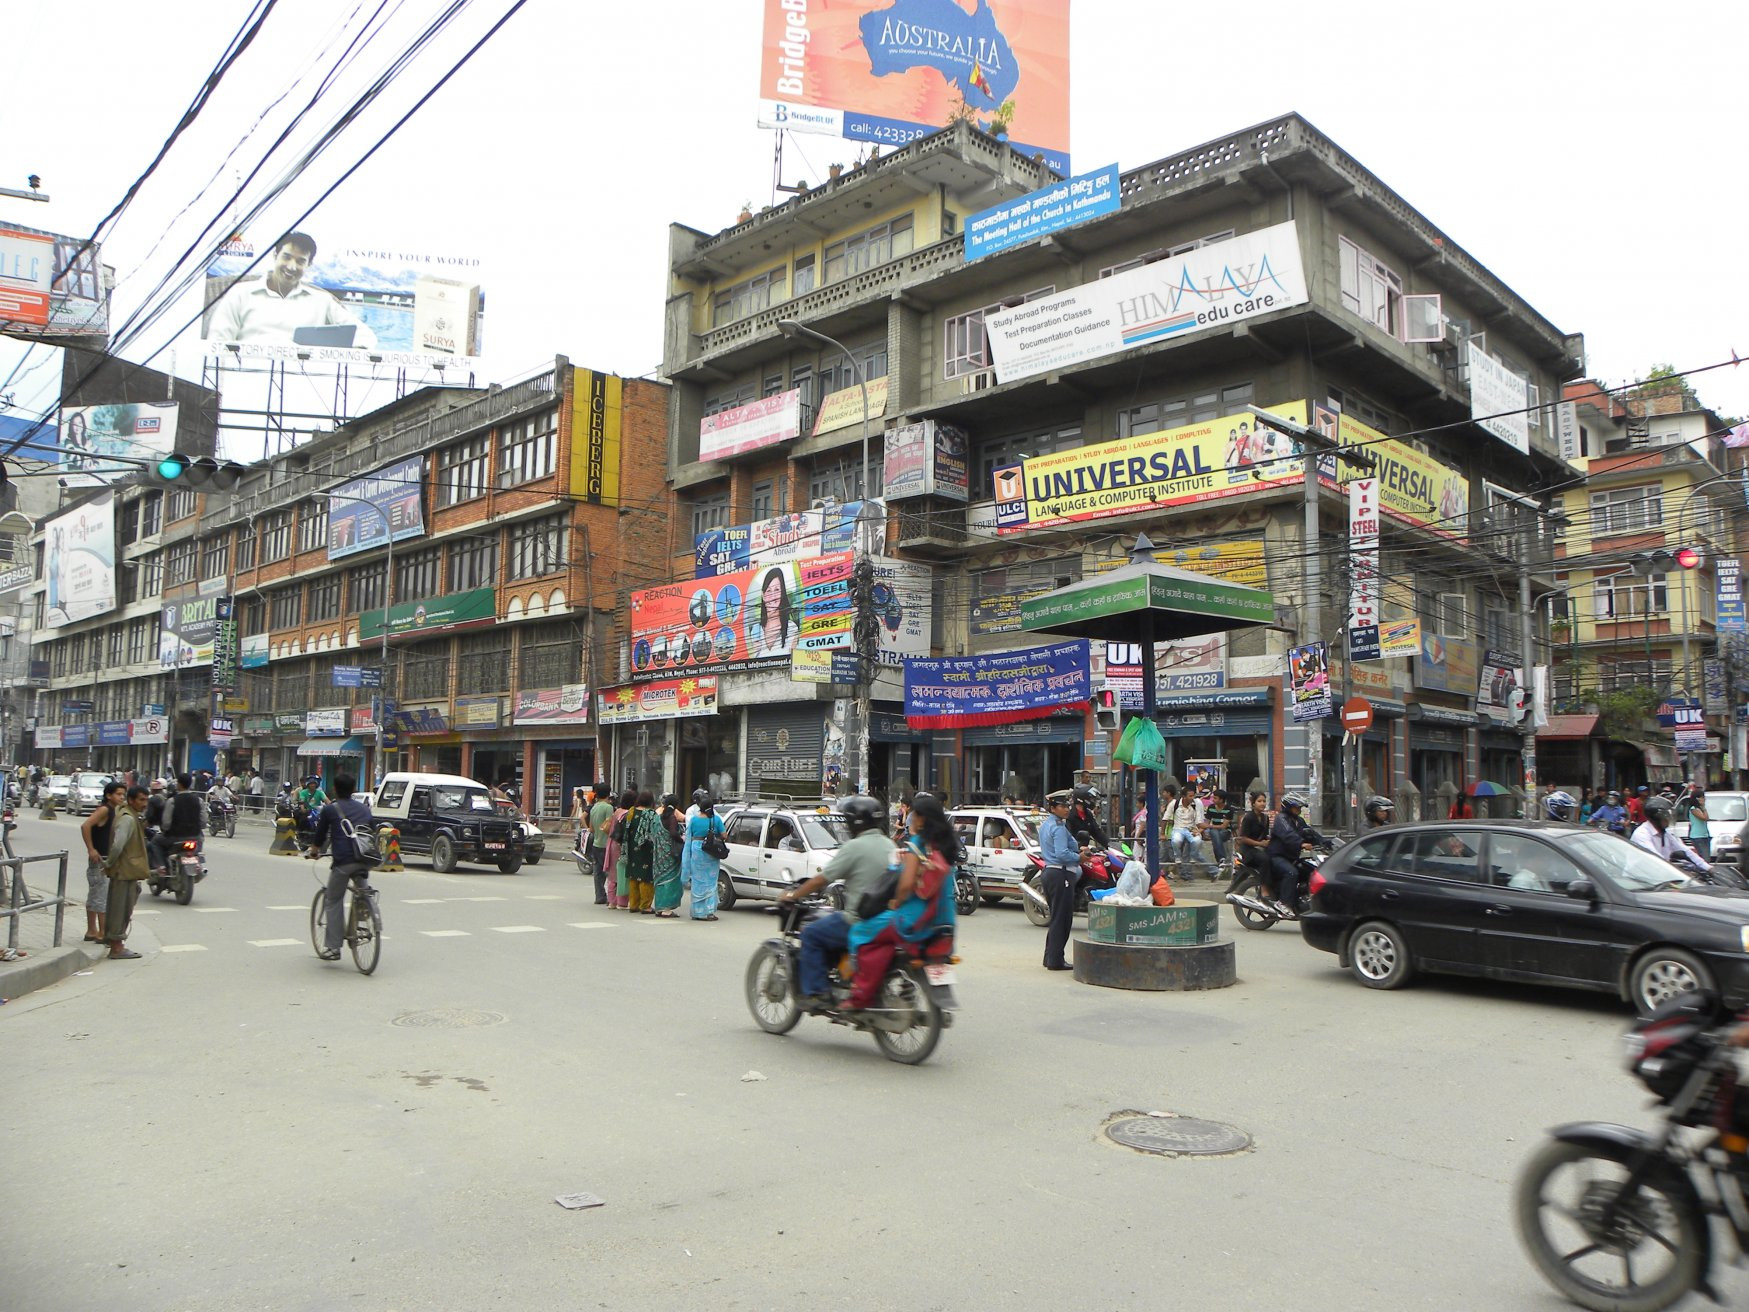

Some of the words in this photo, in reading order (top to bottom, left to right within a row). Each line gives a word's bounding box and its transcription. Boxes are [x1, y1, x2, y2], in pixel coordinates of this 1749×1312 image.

[879, 16, 1002, 70] AUSTRALIA
[850, 122, 872, 135] call:
[971, 234, 982, 247] The
[983, 226, 1008, 243] Meeting
[1009, 219, 1022, 232] Hall
[1022, 217, 1030, 227] of
[1030, 213, 1041, 225] the
[1041, 206, 1064, 221] Church
[1064, 202, 1072, 212] in
[1072, 189, 1111, 210] Kathmandu
[346, 249, 392, 260] INSPIRE
[399, 254, 431, 263] YOUR
[437, 257, 480, 267] WORLD
[1117, 253, 1288, 326] HIMALAYA
[993, 314, 1013, 329] Study
[1014, 307, 1039, 323] Abroad
[1040, 297, 1076, 317] Programs
[1197, 305, 1229, 325] edu
[1233, 292, 1274, 316] care
[1004, 328, 1019, 339] Test
[1020, 315, 1061, 336] Preparation
[1062, 307, 1092, 324] Classes
[423, 333, 456, 348] SURYA
[1020, 328, 1073, 351] Documentation
[1074, 317, 1111, 336] Guidance
[319, 350, 360, 361] SMOKING
[363, 352, 371, 361] IS
[424, 355, 434, 365] TO
[437, 356, 471, 368] HEALTH
[1471, 348, 1494, 376] STUDY
[1495, 365, 1504, 381] IN
[722, 409, 748, 422] ALTA
[760, 394, 791, 410] VISTA
[822, 410, 848, 425] SPANISH
[589, 380, 603, 494] ICEBERG
[1027, 462, 1040, 471] TEST
[1040, 454, 1078, 469] PREPARATION
[1083, 449, 1102, 459] STUDY
[1103, 444, 1128, 456] ABROAD
[1133, 436, 1169, 450] LANGUAGES
[1175, 427, 1212, 441] COMPUTING
[1032, 444, 1212, 503] UNIVERSAL
[1342, 437, 1436, 507] UNIVERSAL
[891, 481, 920, 492] UNIVERSAL
[1089, 495, 1097, 507] &
[1098, 486, 1155, 506] COMPUTER
[1158, 475, 1214, 497] INSTITUTE
[1380, 488, 1410, 510] COMPUTER
[998, 501, 1025, 516] ULCI
[1092, 510, 1112, 518] Email:
[1351, 519, 1378, 536] STEEL
[723, 530, 748, 541] TOEFL
[767, 524, 801, 549] Study
[716, 540, 742, 553] IELTS
[772, 543, 796, 557] Abroad
[709, 551, 732, 566] SAT
[799, 560, 812, 569] Test
[812, 554, 846, 568] Preparation
[1716, 560, 1740, 568] TOEFL
[716, 560, 736, 576] GRE
[807, 565, 845, 579] IELTS
[1717, 568, 1739, 576] IELTS
[1720, 576, 1737, 585] SAT
[644, 586, 682, 602] REACTION
[804, 583, 846, 597] TOEFL
[906, 592, 922, 601] IELTS
[1720, 585, 1737, 593] GRE
[1717, 593, 1741, 602] GMAT
[644, 604, 663, 616] Nepal
[812, 601, 838, 613] SAT
[905, 601, 923, 610] TOEFL
[811, 618, 838, 630] GRE
[907, 619, 920, 628] GRE
[905, 627, 922, 637] GMAT
[806, 636, 843, 648] GMAT
[1388, 642, 1416, 652] UNIVERSAL
[1107, 643, 1143, 664] UK
[1176, 672, 1218, 688] 421928
[643, 688, 676, 700] MICROTEK
[1216, 693, 1258, 707] Corner
[627, 714, 640, 723] Lights
[1674, 709, 1703, 724] UK
[213, 719, 232, 731] UK
[1095, 915, 1114, 931] 4321
[1128, 919, 1148, 932] SMS
[1150, 910, 1178, 928] JAM
[1179, 911, 1188, 920] to
[1167, 919, 1195, 935] 4321
